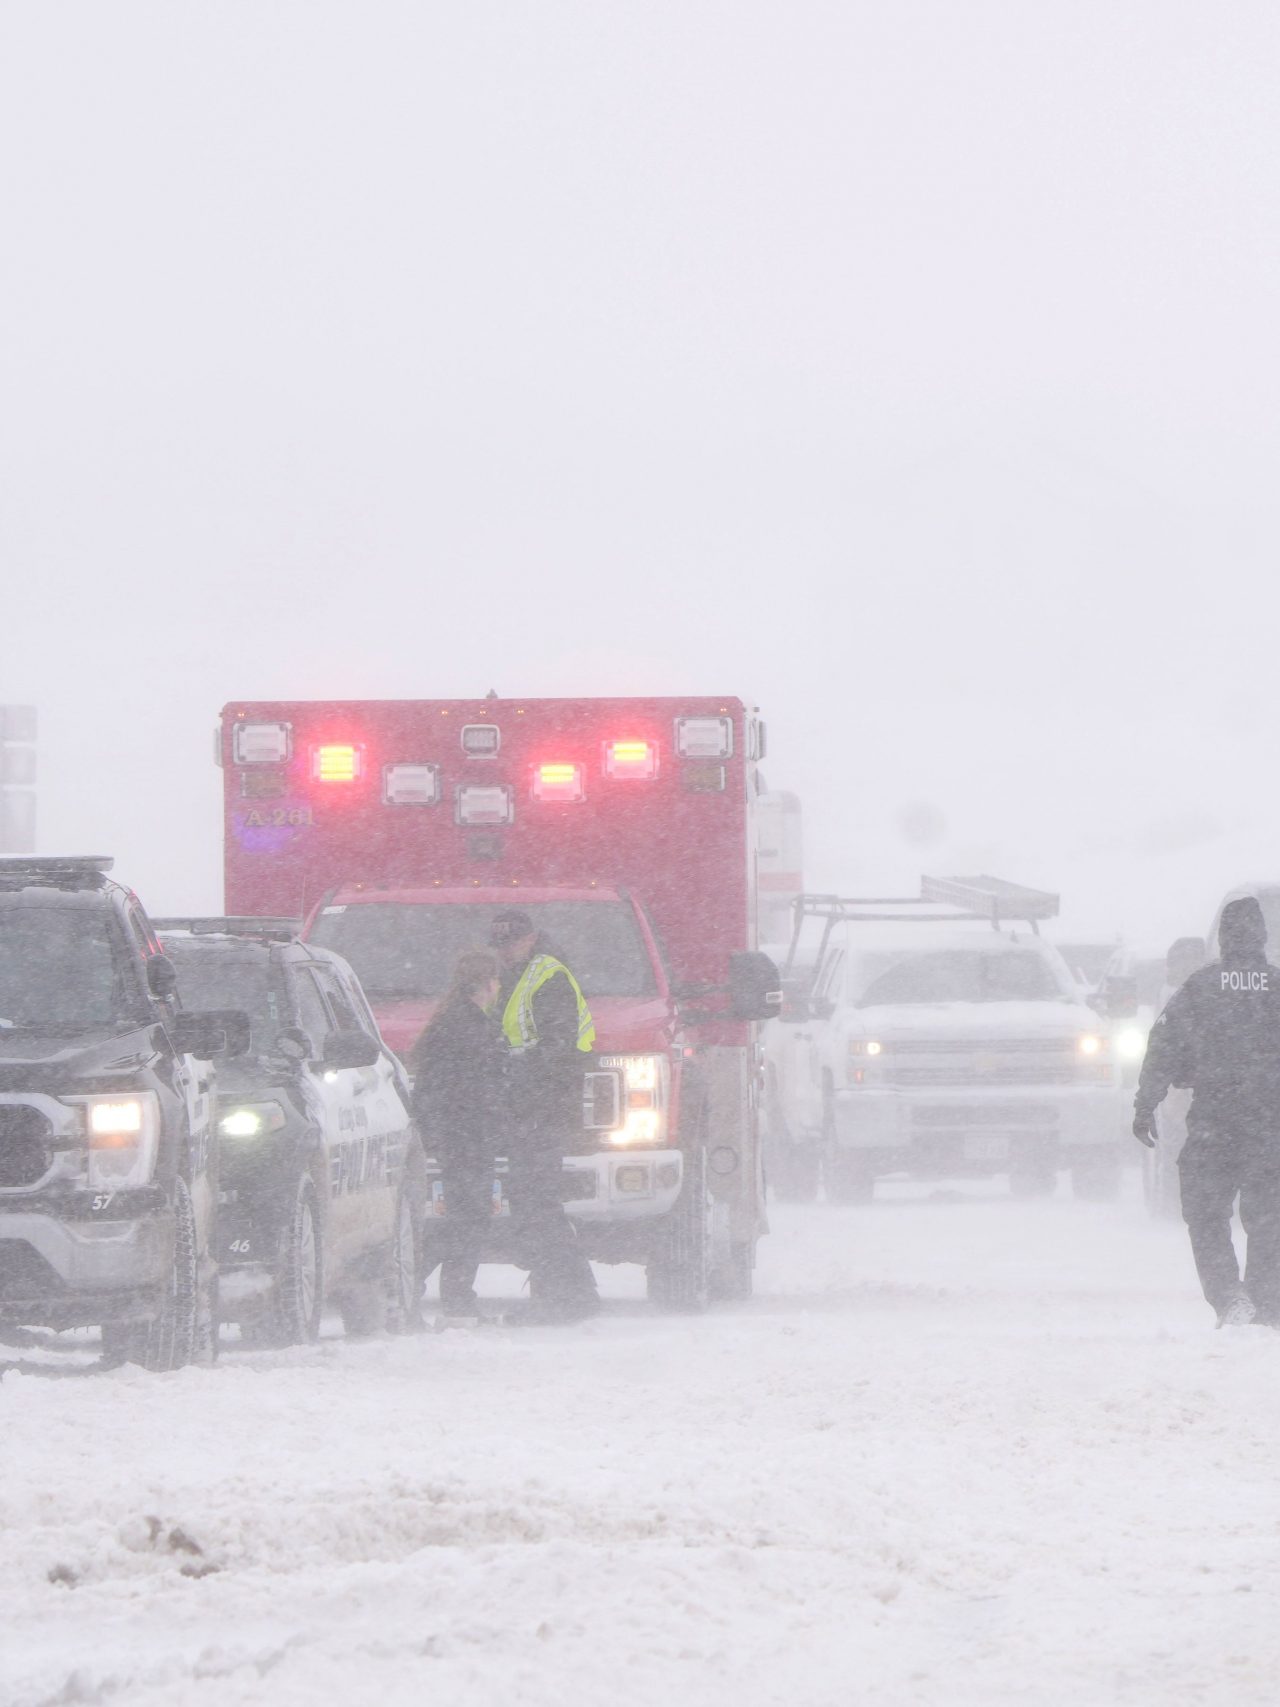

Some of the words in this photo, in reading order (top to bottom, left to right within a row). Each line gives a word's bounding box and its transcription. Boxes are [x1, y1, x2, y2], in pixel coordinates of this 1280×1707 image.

[1221, 971, 1269, 991] POLICE
[92, 1194, 113, 1210] 57
[229, 1240, 250, 1252] 46
